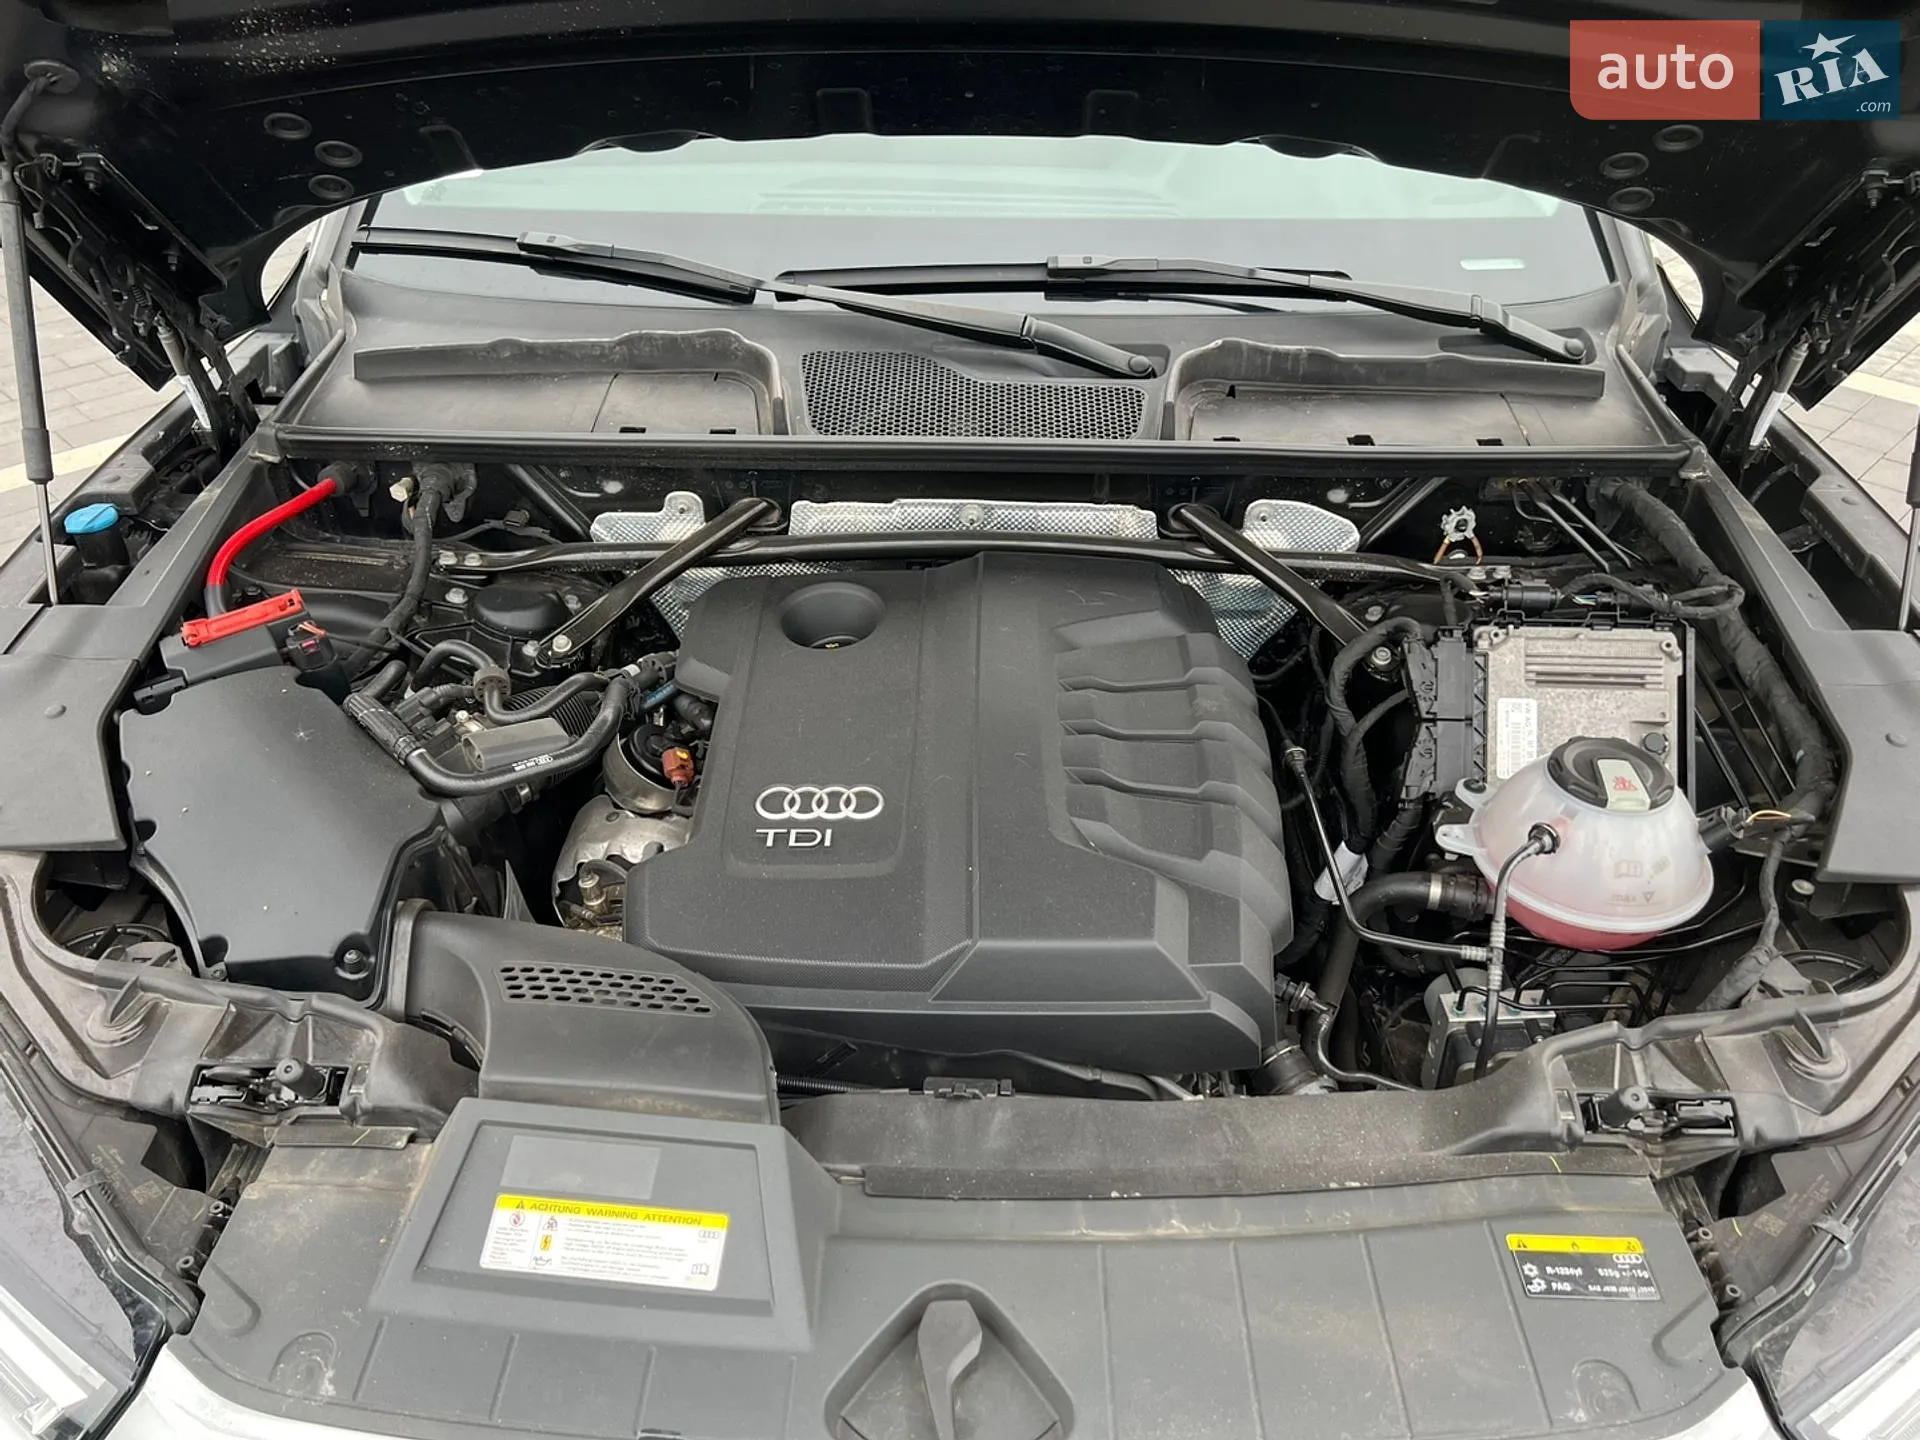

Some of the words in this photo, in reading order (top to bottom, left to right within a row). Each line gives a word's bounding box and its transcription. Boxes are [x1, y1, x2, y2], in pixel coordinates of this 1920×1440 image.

[756, 829, 833, 847] TDI
[530, 1202, 581, 1215] ACHTUNG
[586, 1207, 638, 1220] WARNING
[643, 1213, 702, 1226] ATTENTION
